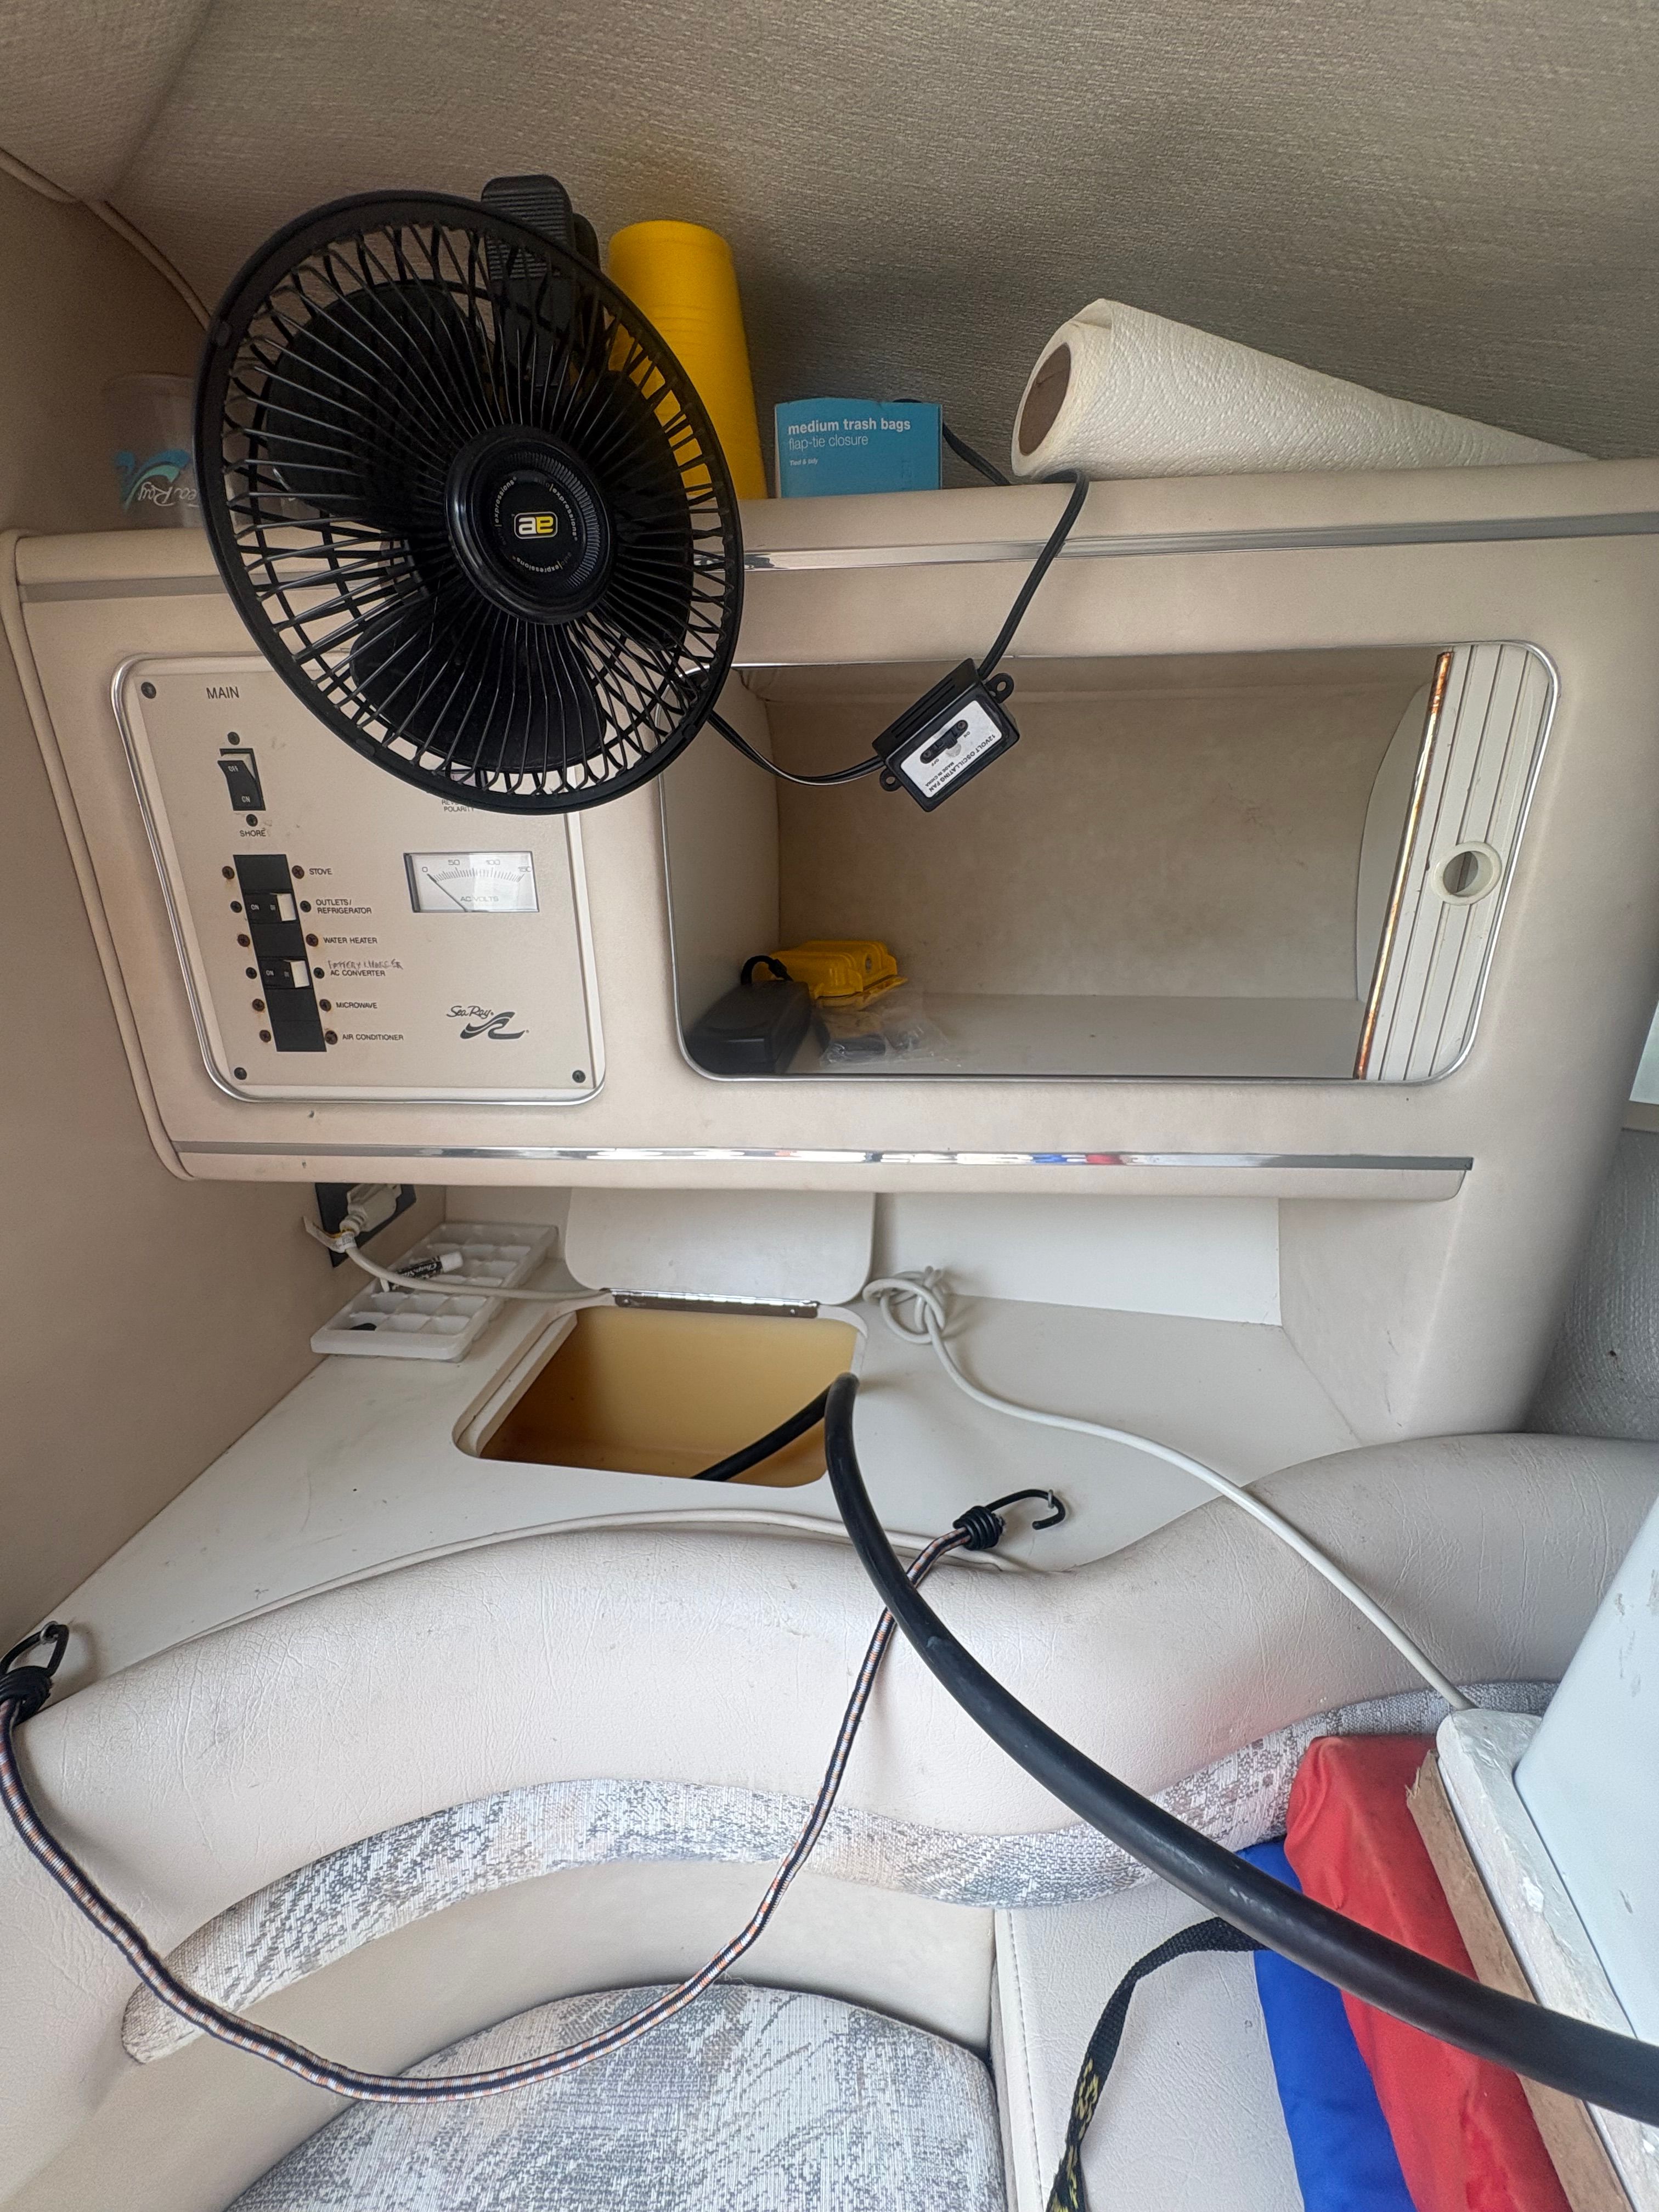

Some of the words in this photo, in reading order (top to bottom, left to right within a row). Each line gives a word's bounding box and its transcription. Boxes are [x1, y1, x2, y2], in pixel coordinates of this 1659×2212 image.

[788, 419, 839, 435] medium
[843, 418, 877, 431] trash
[881, 417, 911, 432] bags
[788, 436, 826, 452] flap-tie
[828, 433, 869, 447] closure
[206, 686, 240, 699] MAIN
[940, 751, 975, 783] OSCILLATING
[942, 761, 955, 772] MADE
[926, 774, 939, 787] CHINA
[928, 781, 941, 792] FAN
